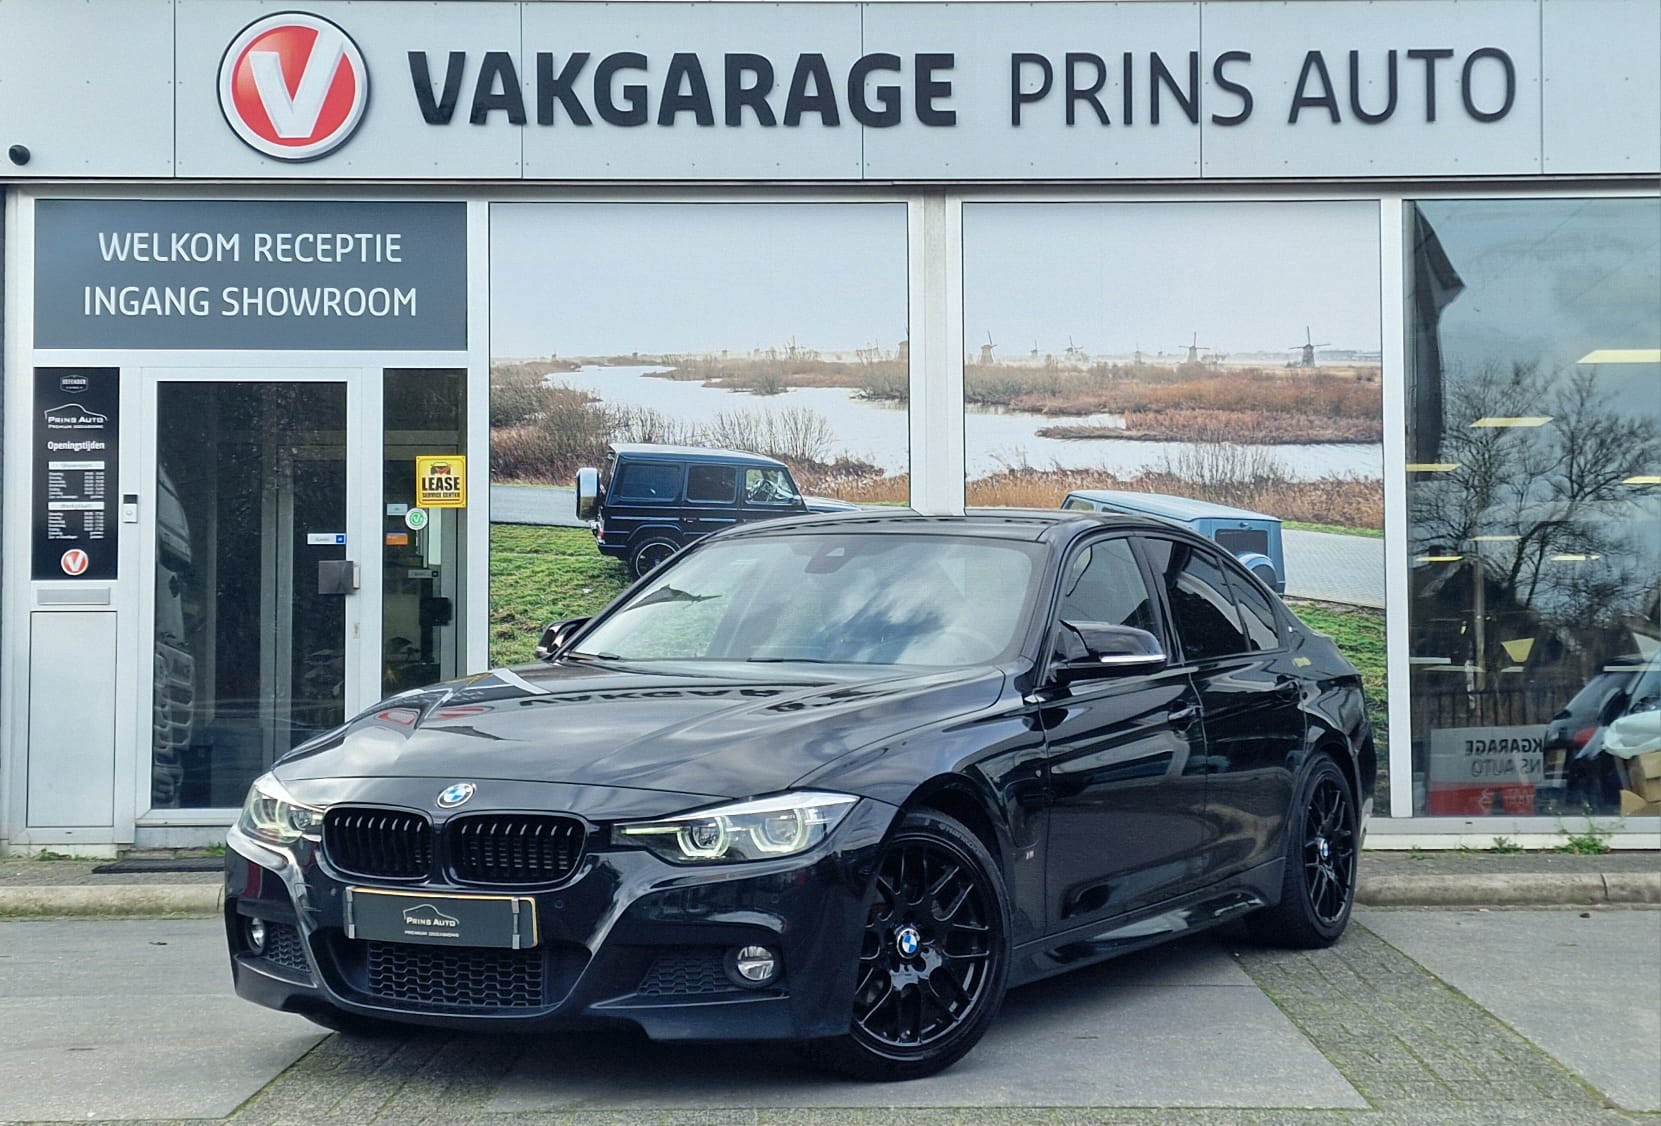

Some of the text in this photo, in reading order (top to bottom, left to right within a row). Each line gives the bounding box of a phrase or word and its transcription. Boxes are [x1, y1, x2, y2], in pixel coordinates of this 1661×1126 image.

[249, 30, 345, 138] V
[407, 47, 1517, 128] VAKGARAGE PRINS AUTO
[98, 232, 402, 262] WELKOM RECEPTIE
[84, 285, 417, 317] INGANG SHOWROOM
[47, 440, 105, 452] Openingstijden
[421, 477, 460, 491] LEASE
[405, 916, 456, 928] PRINS AUTO
